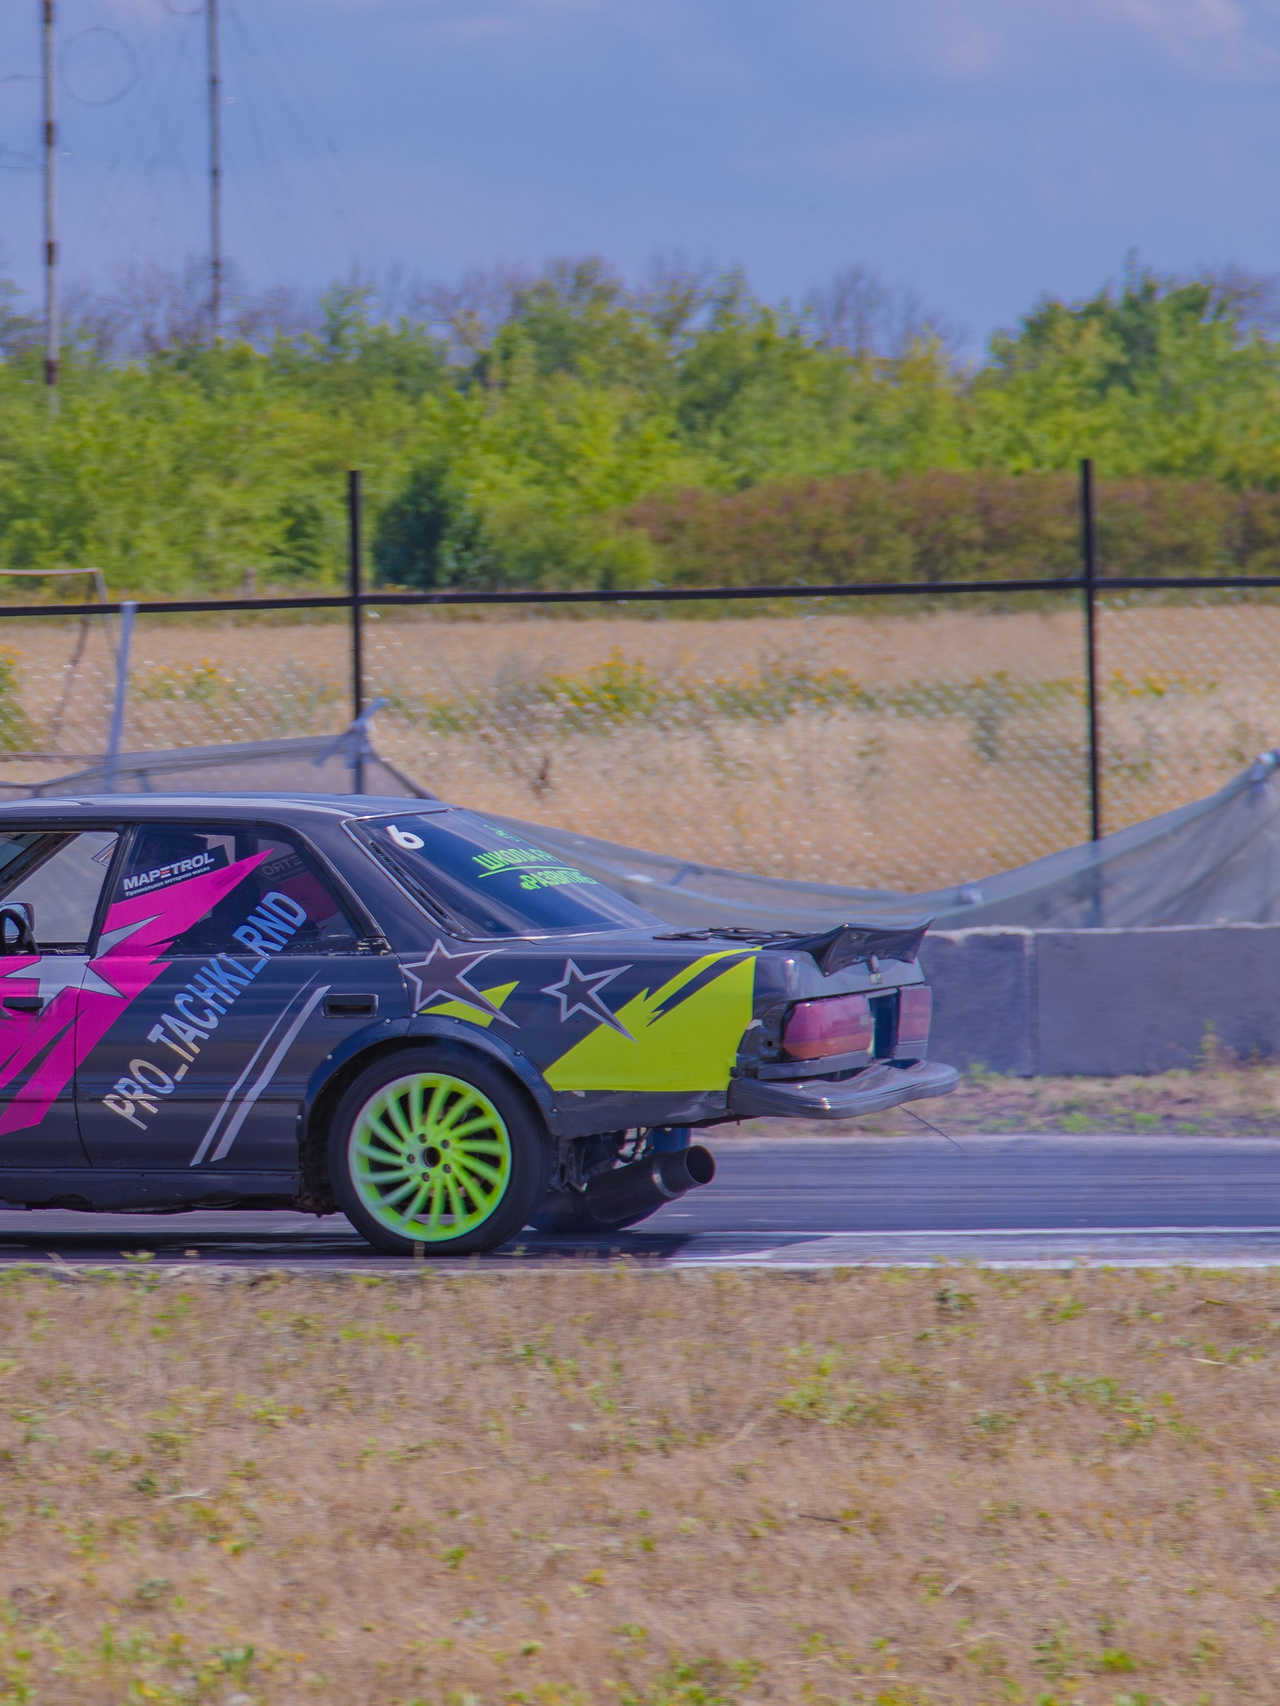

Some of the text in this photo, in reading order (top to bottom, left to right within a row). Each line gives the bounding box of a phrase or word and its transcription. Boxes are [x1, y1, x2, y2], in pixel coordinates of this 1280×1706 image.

[385, 824, 425, 850] 6
[123, 852, 215, 891] MAPETROL
[125, 866, 211, 897] Премиальное моторное масло
[102, 891, 308, 1131] PRO_TACHKI_RND
